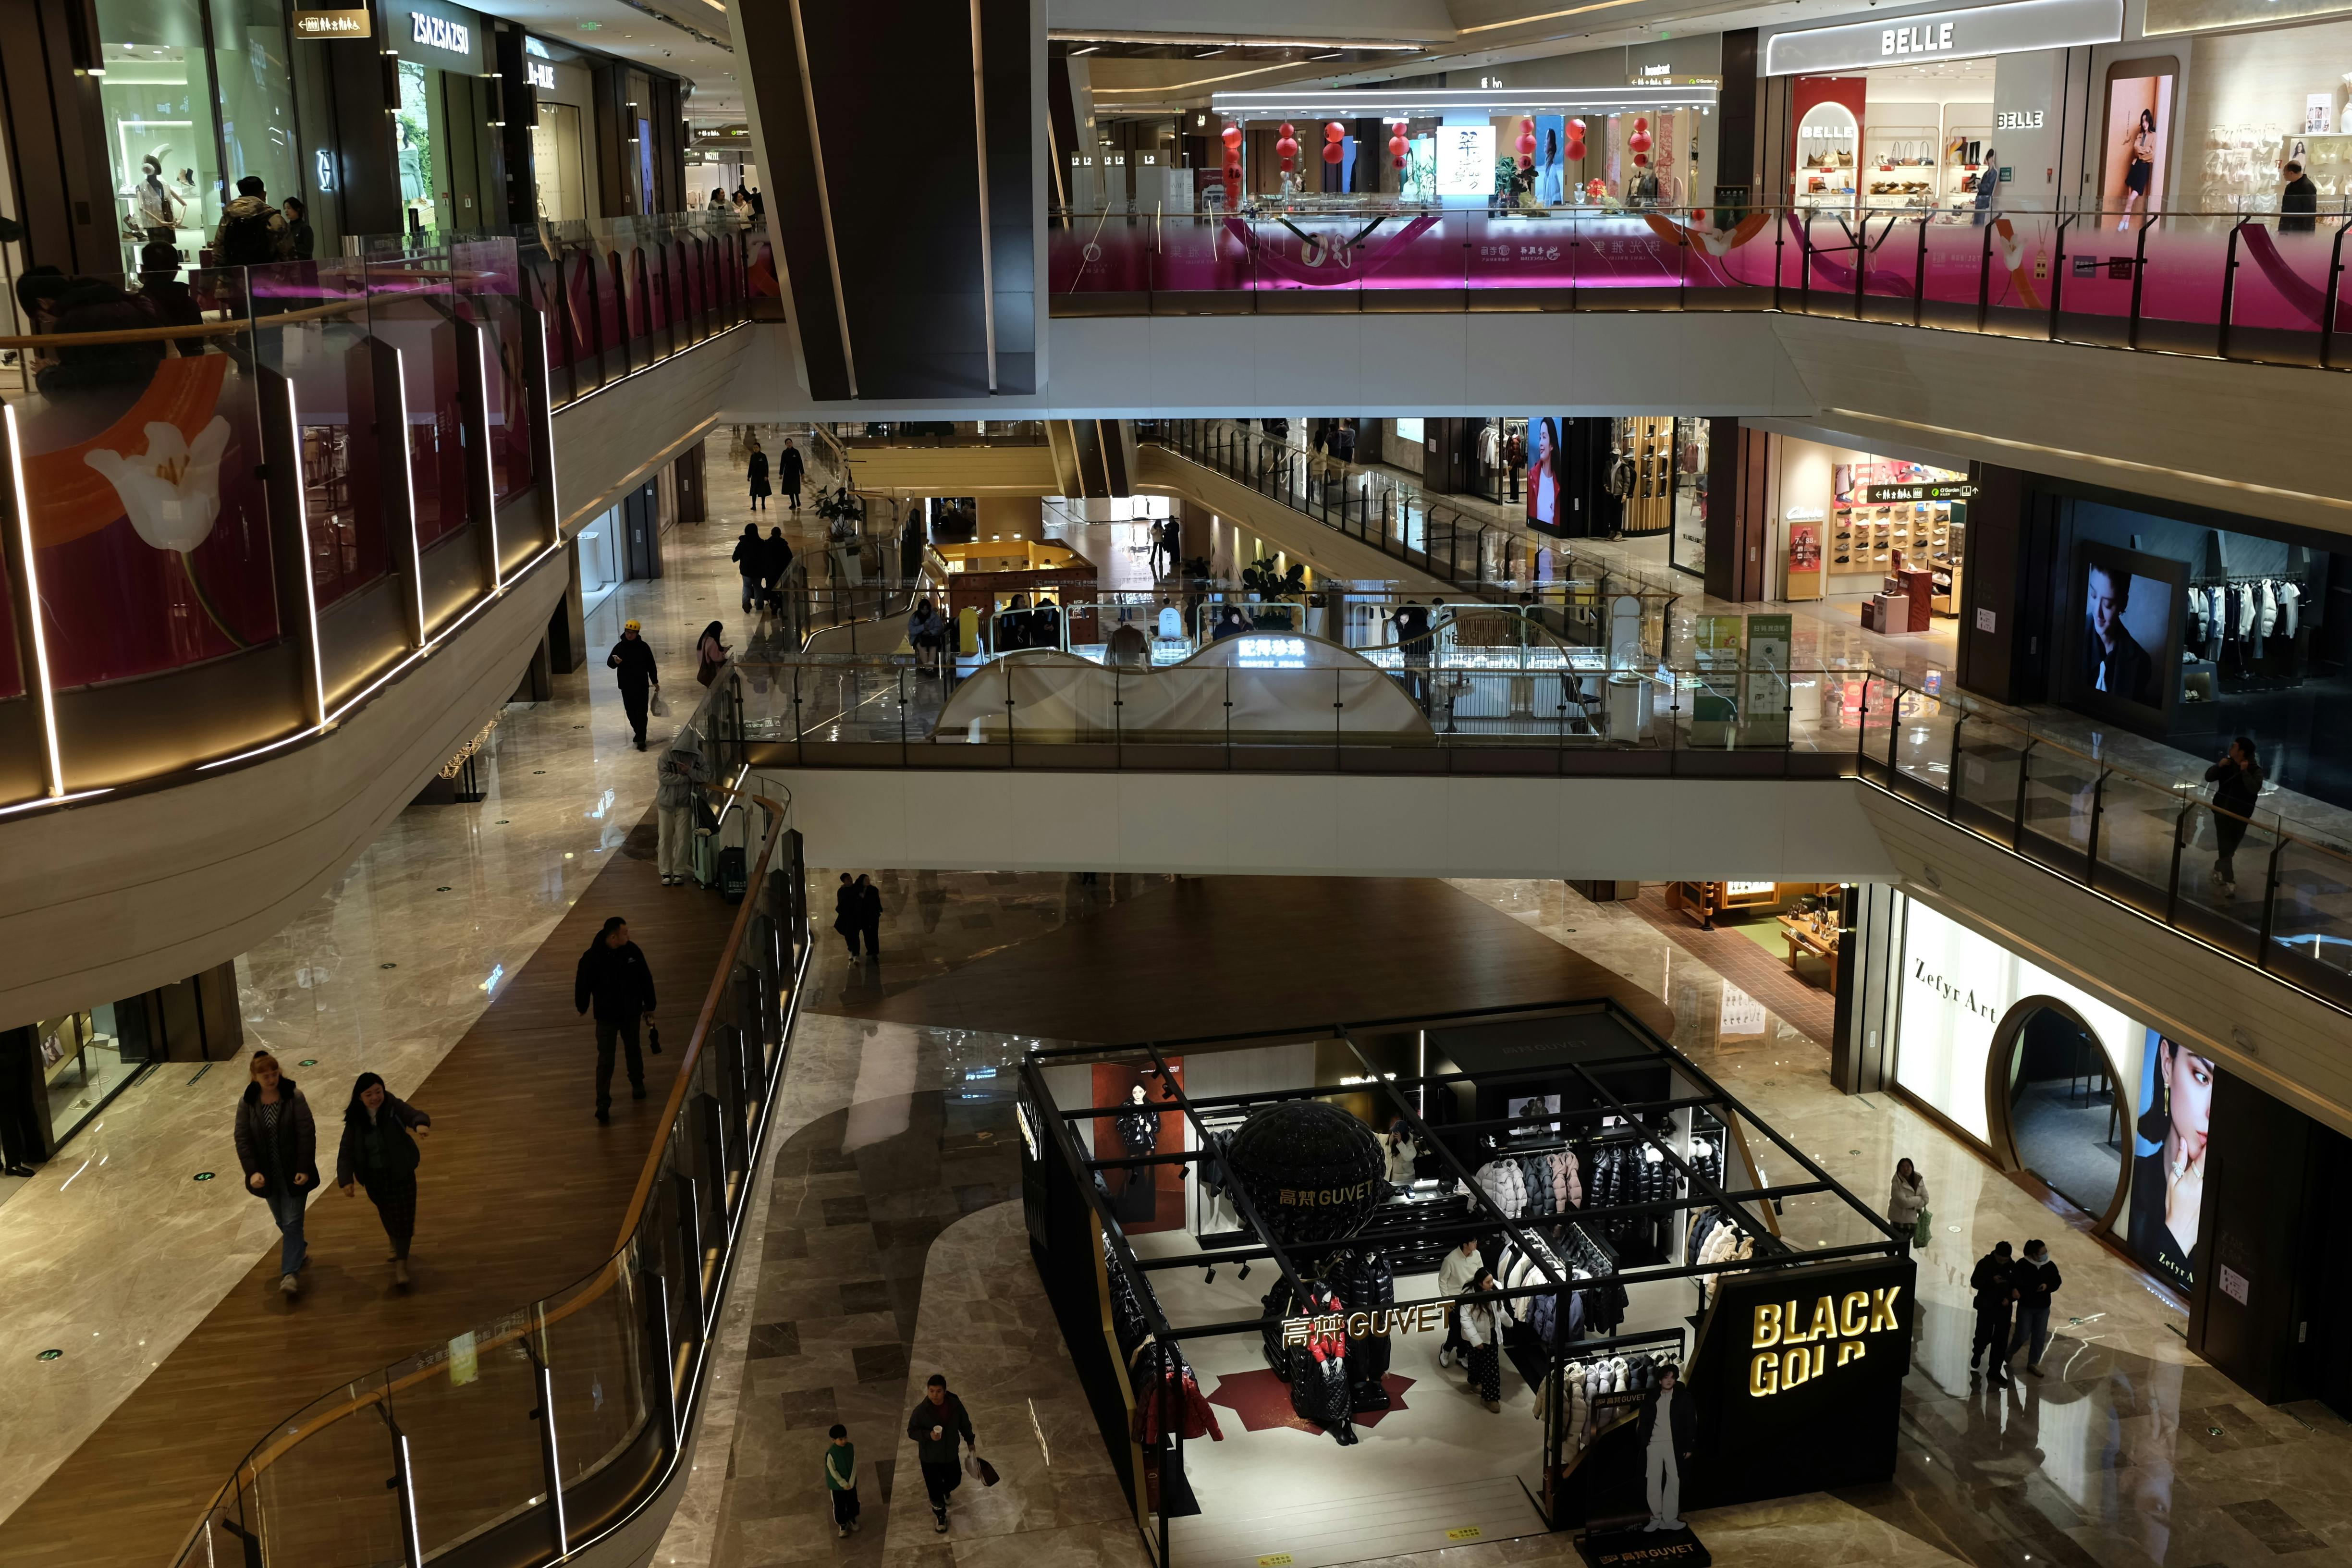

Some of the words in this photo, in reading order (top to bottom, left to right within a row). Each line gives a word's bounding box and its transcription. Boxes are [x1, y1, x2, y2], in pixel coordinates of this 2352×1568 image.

[410, 12, 469, 54] ZSAZSAZSU
[1881, 22, 1954, 56] BELLE
[1997, 111, 2044, 129] BELLE
[1801, 126, 1854, 138] BELLE
[1072, 157, 1079, 165] L2
[1083, 157, 1091, 165] L2
[1104, 157, 1111, 165] L2
[1115, 156, 1124, 165] L2
[1144, 156, 1155, 164] L2
[1915, 958, 1961, 1002] Zefyr
[1965, 990, 1997, 1023] Art
[1319, 1179, 1373, 1205] GUVET
[2158, 1251, 2185, 1276] Zefyr
[1348, 1299, 1456, 1341] GUVET
[1752, 1286, 1901, 1349] BLACK
[1621, 1393, 1646, 1402] GUVET
[1648, 1544, 1694, 1557] GUVET
